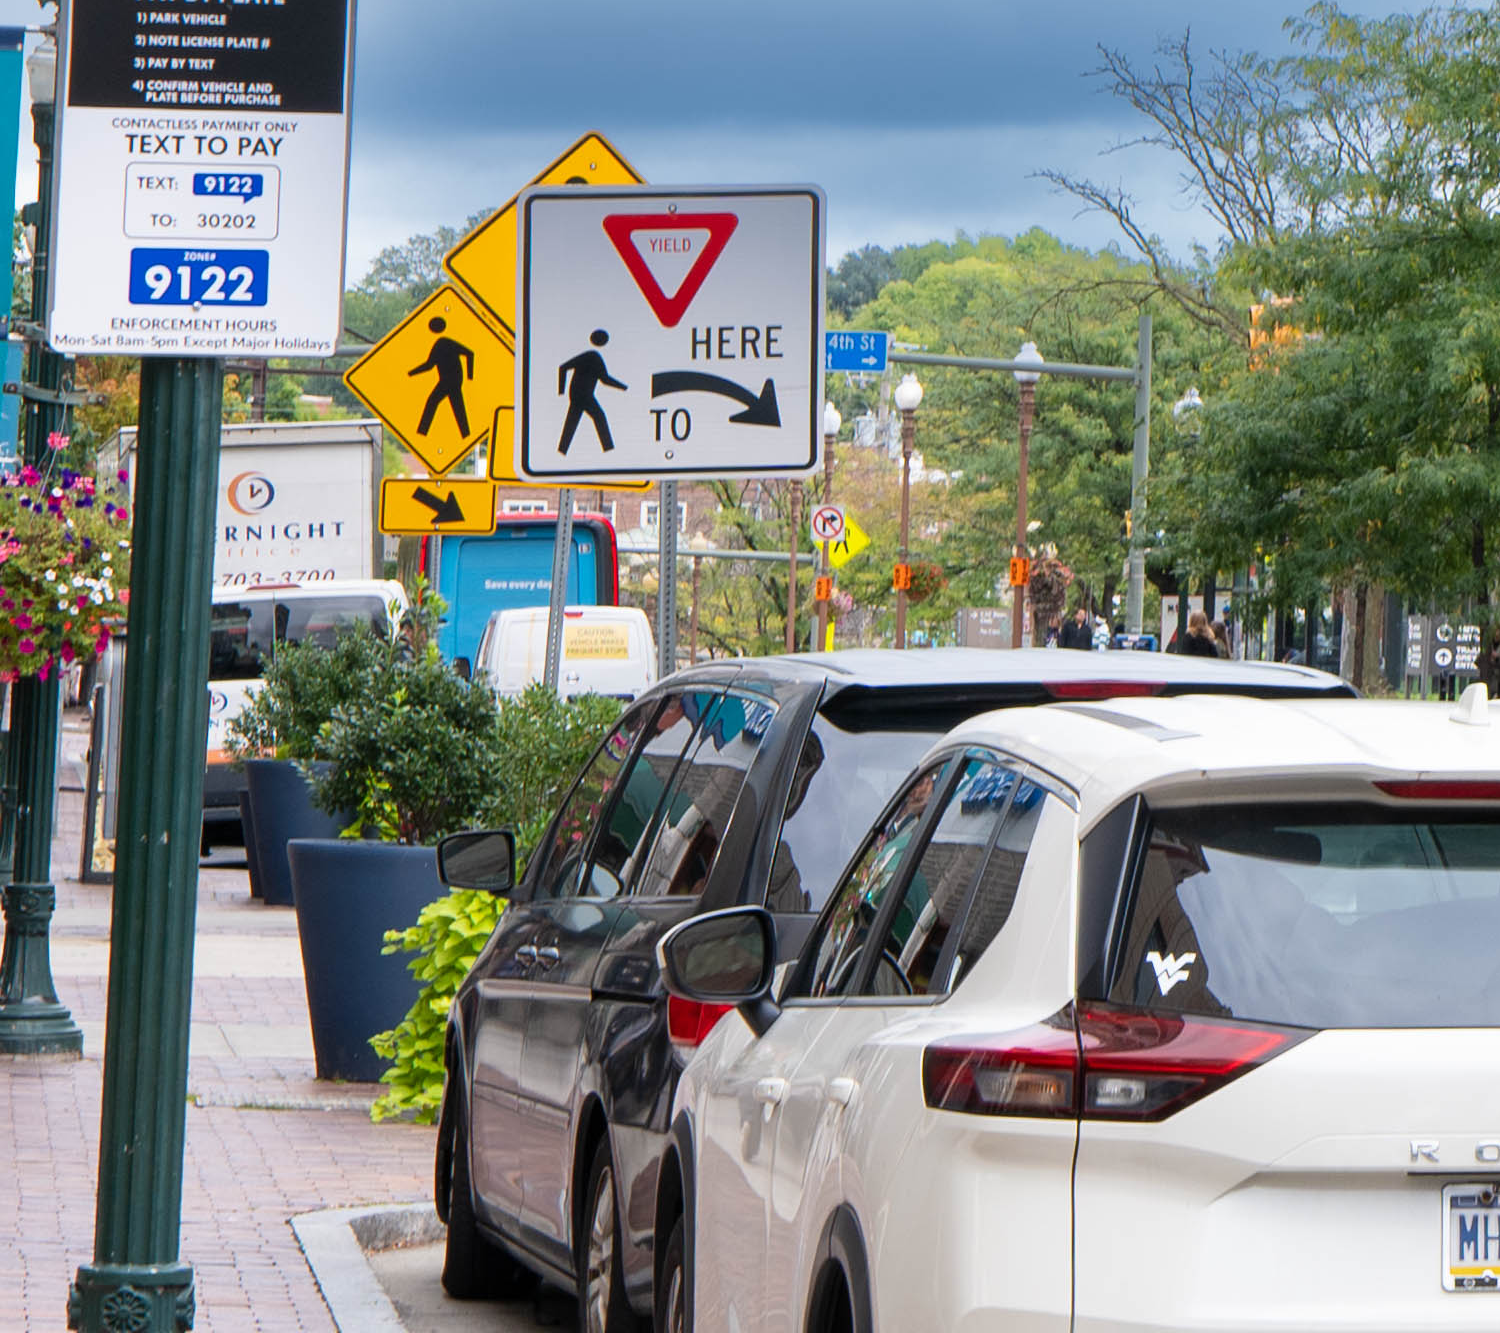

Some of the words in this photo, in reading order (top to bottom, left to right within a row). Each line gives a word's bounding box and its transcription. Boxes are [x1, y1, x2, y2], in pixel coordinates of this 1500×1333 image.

[137, 12, 147, 25] 1)
[150, 13, 179, 24] PARK
[183, 14, 226, 26] VEHICLE
[135, 35, 146, 47] 2)
[149, 35, 179, 47] NOTE
[182, 37, 224, 48] LICENSE
[227, 37, 258, 49] PLATE
[134, 57, 145, 69] 3)
[148, 58, 169, 69] PAY
[171, 58, 185, 70] BY
[188, 58, 215, 70] TEXT
[132, 81, 144, 93] 4)
[147, 81, 199, 93] CONFIRM
[202, 82, 245, 94] VEHICLE
[247, 83, 272, 94] AND
[145, 92, 177, 104] PLATE
[180, 93, 221, 105] BEFORE
[224, 93, 281, 106] PURCHASE
[112, 118, 198, 130] CONTACTLESS
[202, 120, 260, 132] PAYMENT
[265, 122, 298, 133] ONLY
[125, 134, 184, 155] TEXT
[194, 136, 228, 155] TO
[238, 137, 283, 157] PAY
[137, 177, 178, 190] TEXT:
[204, 176, 253, 193] 9122
[150, 214, 176, 227] TO:
[197, 214, 256, 229] 30202
[649, 237, 692, 254] YIELD
[145, 265, 254, 301] 9122
[111, 318, 222, 332] ENFORCEMENT
[225, 319, 277, 332] HOURS
[55, 334, 111, 347] Mon-Sat
[116, 335, 178, 349] 8am-5pm
[183, 336, 228, 351] Except
[232, 336, 270, 351] Major
[274, 337, 331, 351] Holidays
[691, 326, 784, 360] HERE
[829, 334, 854, 350] 4th
[860, 335, 875, 351] St
[650, 408, 691, 442] TO
[215, 522, 344, 542] RNIGHT
[485, 580, 507, 590] Save
[509, 580, 535, 591] every
